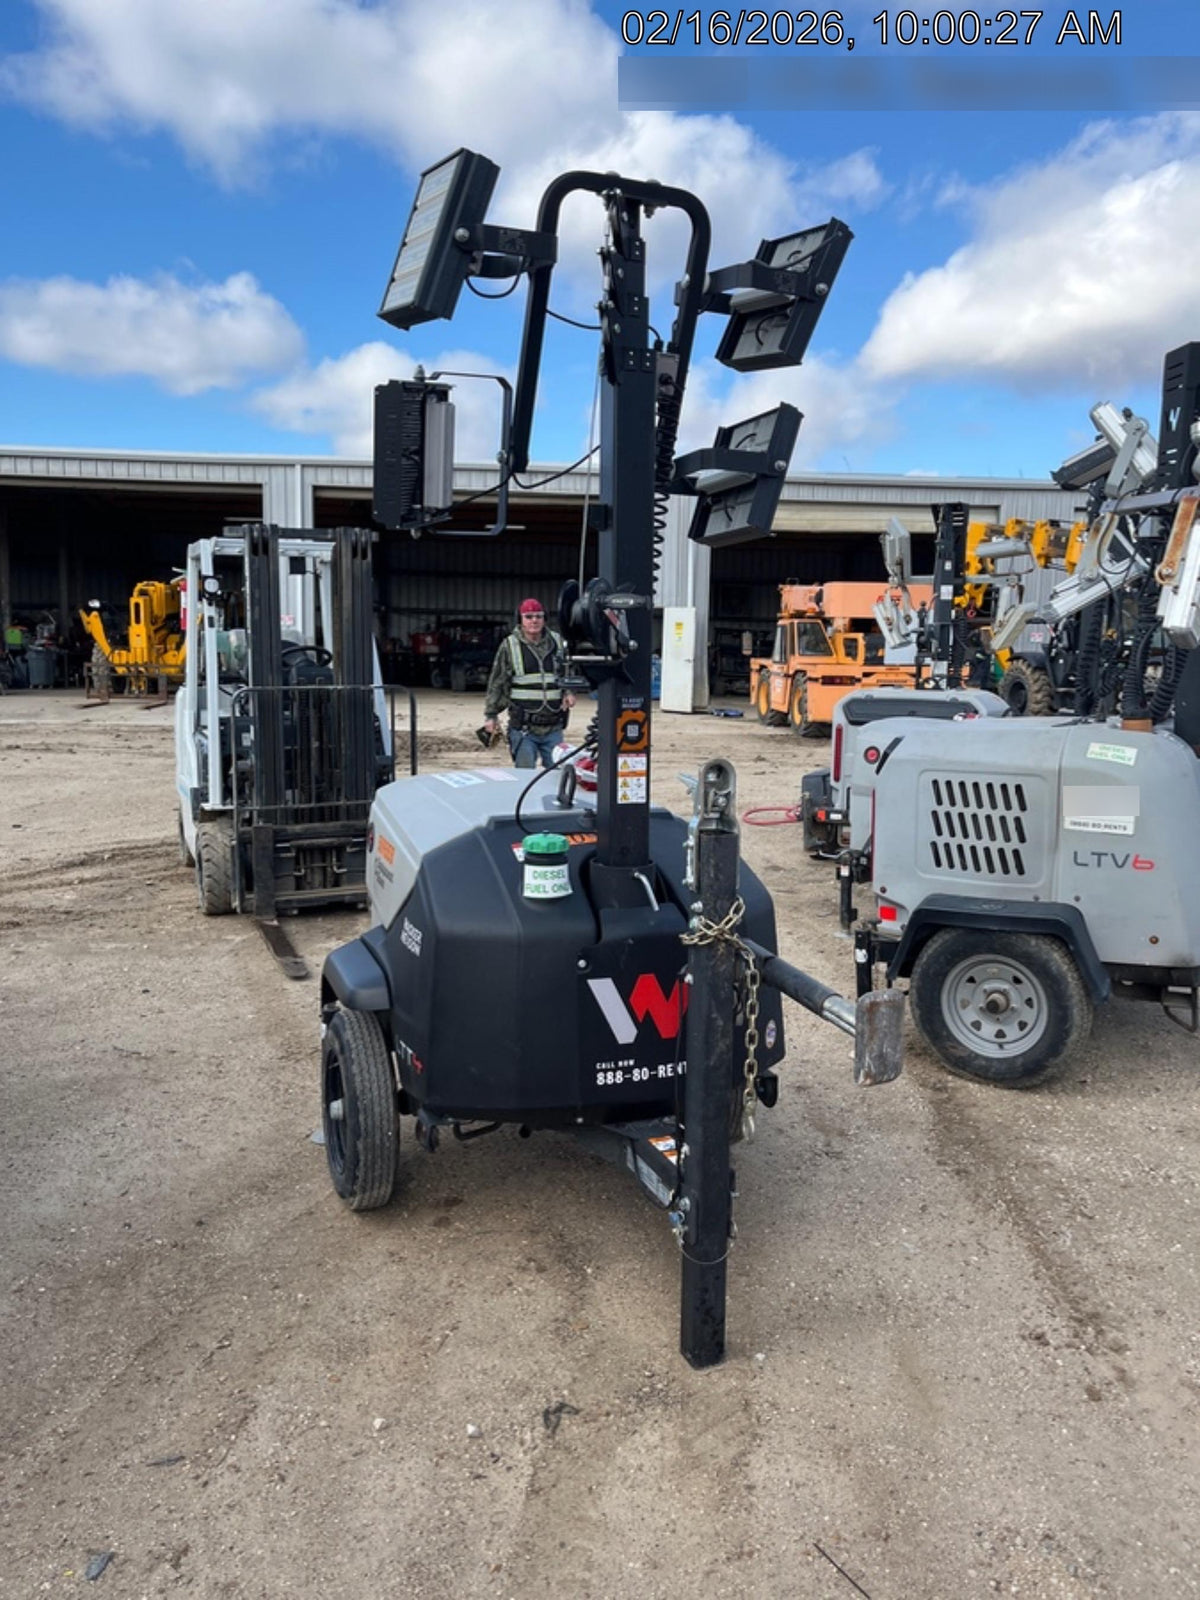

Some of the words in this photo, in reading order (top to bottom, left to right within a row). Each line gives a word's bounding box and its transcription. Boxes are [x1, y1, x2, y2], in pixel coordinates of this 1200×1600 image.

[1073, 850, 1155, 871] LTV6
[533, 869, 566, 880] DIESEL
[525, 883, 549, 893] FUEL
